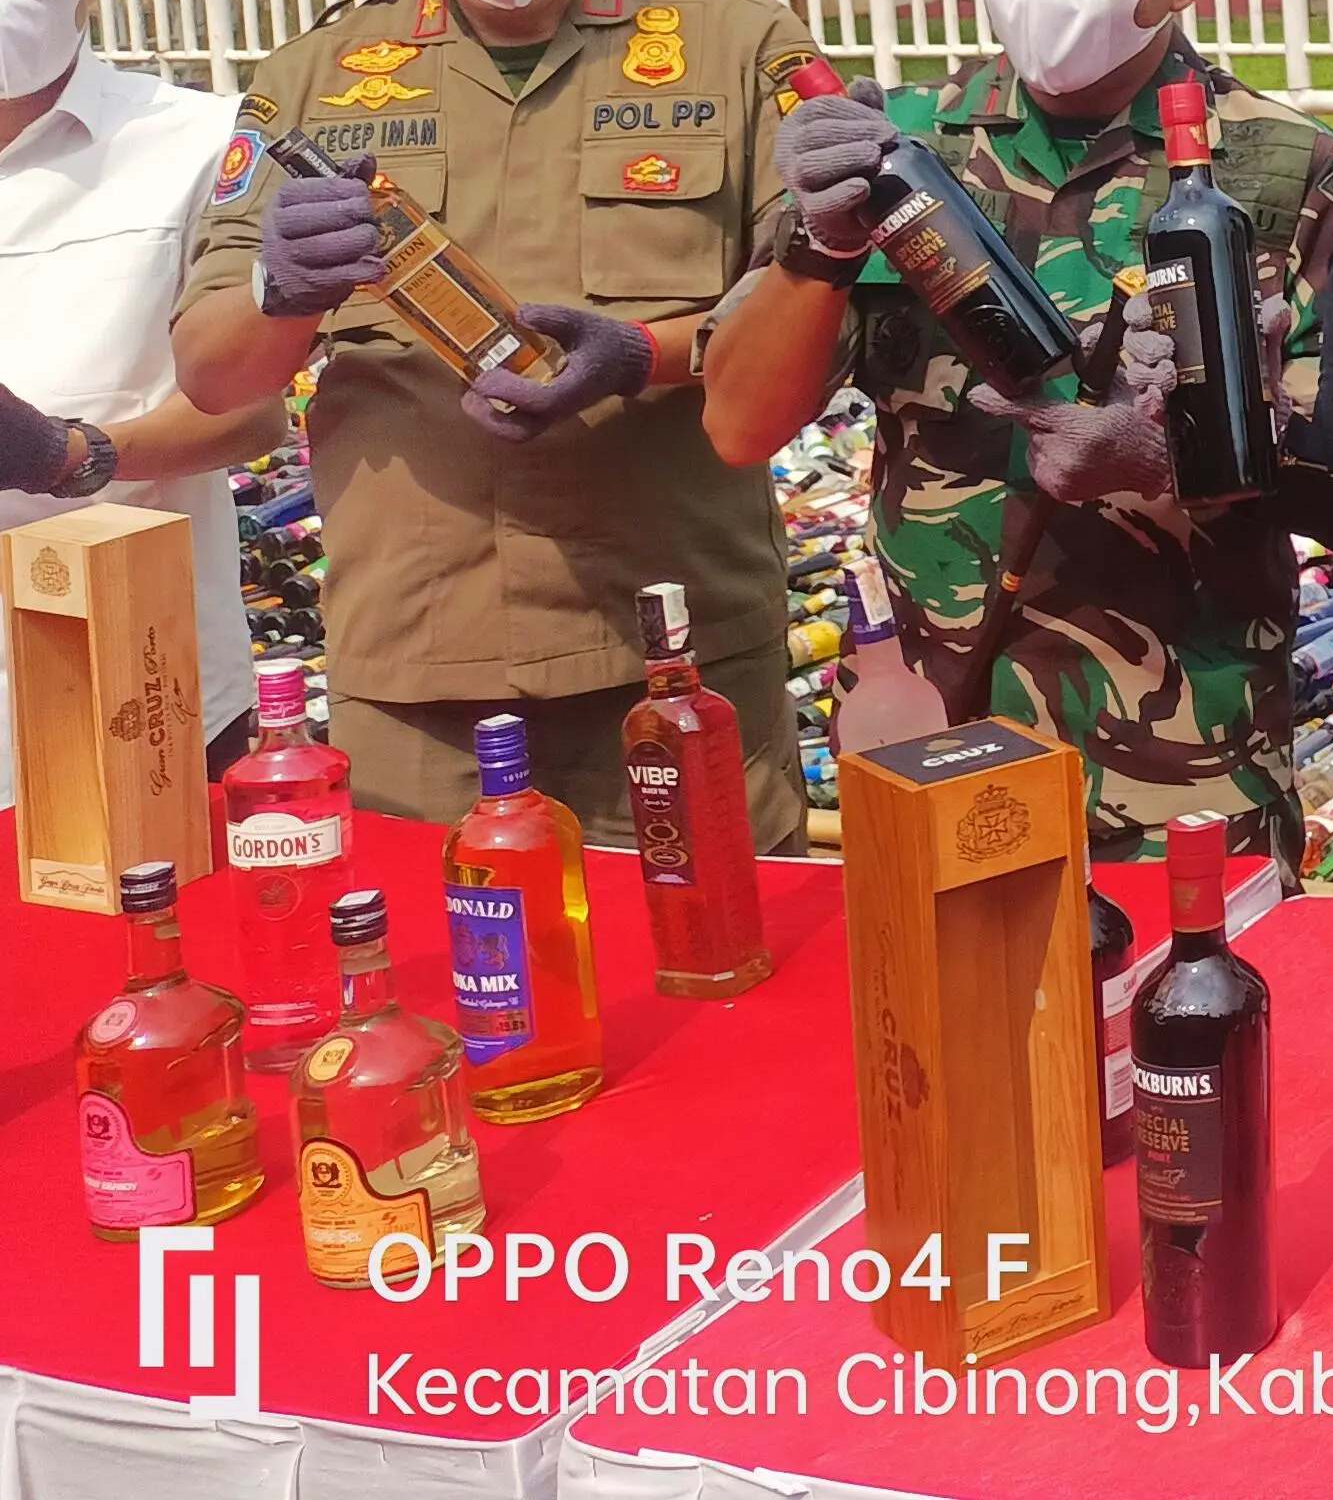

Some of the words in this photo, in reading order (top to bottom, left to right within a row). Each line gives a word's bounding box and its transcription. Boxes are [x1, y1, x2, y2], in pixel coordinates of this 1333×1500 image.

[594, 102, 660, 132] POL
[672, 100, 716, 129] PP
[314, 122, 375, 153] CECEP
[380, 117, 438, 148] IMAM
[386, 236, 426, 275] OLTON
[895, 226, 939, 258] SPECIAL
[145, 677, 165, 747] CRUZ
[922, 743, 1004, 767] CRUZ
[233, 832, 321, 858] GORDON'S
[480, 973, 519, 993] MIX
[1137, 1111, 1189, 1135] SPECIAL
